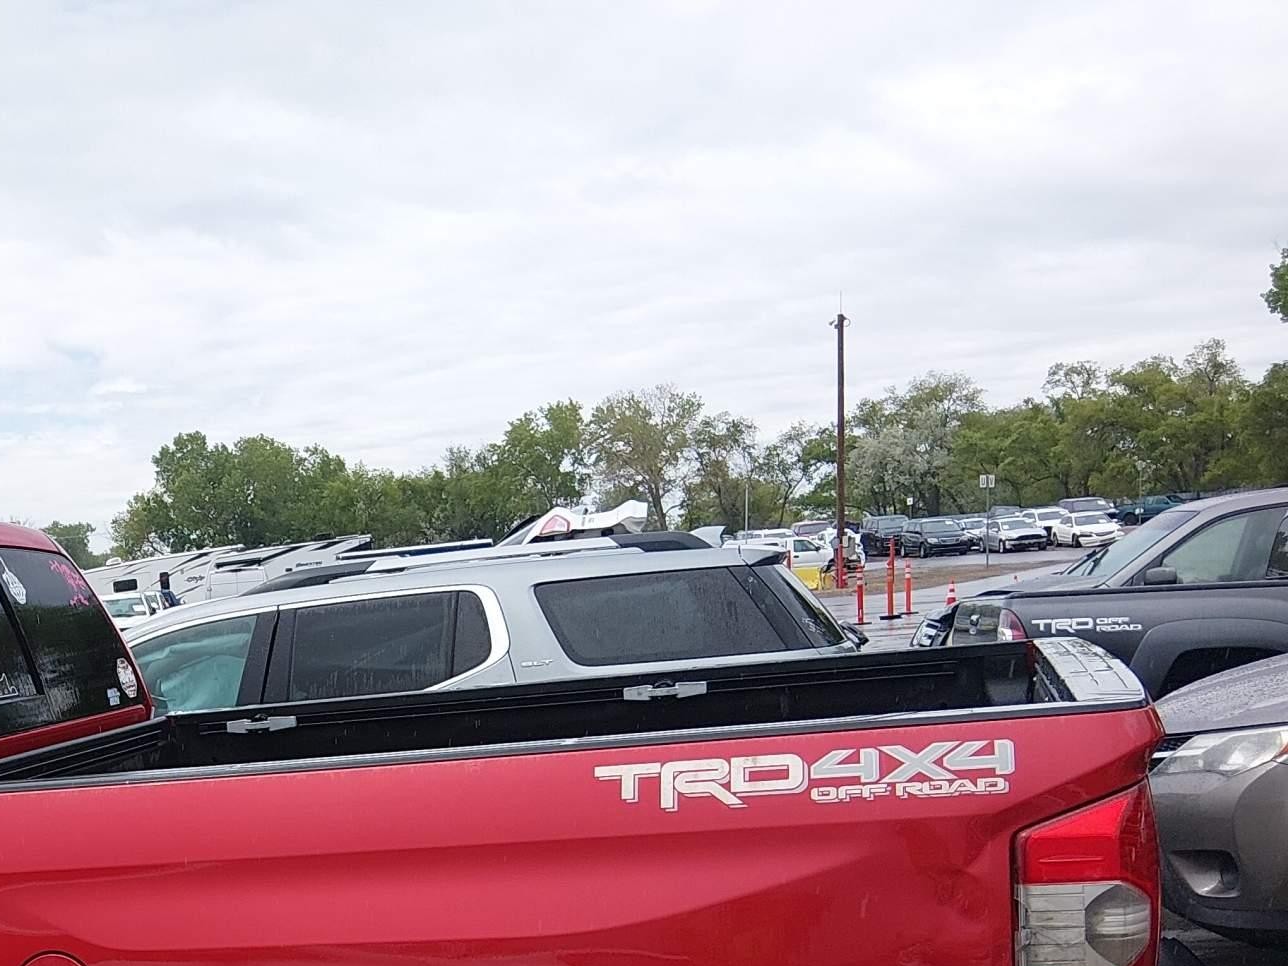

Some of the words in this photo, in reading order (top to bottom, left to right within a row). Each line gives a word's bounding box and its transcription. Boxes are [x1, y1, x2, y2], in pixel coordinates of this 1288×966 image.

[1032, 617, 1094, 635] TRD
[1096, 616, 1130, 625] OFF
[1096, 623, 1142, 633] ROAD
[594, 753, 809, 812] TRD
[811, 739, 1015, 784] 4X4
[811, 783, 891, 804] OFF
[895, 777, 1010, 799] ROAD
